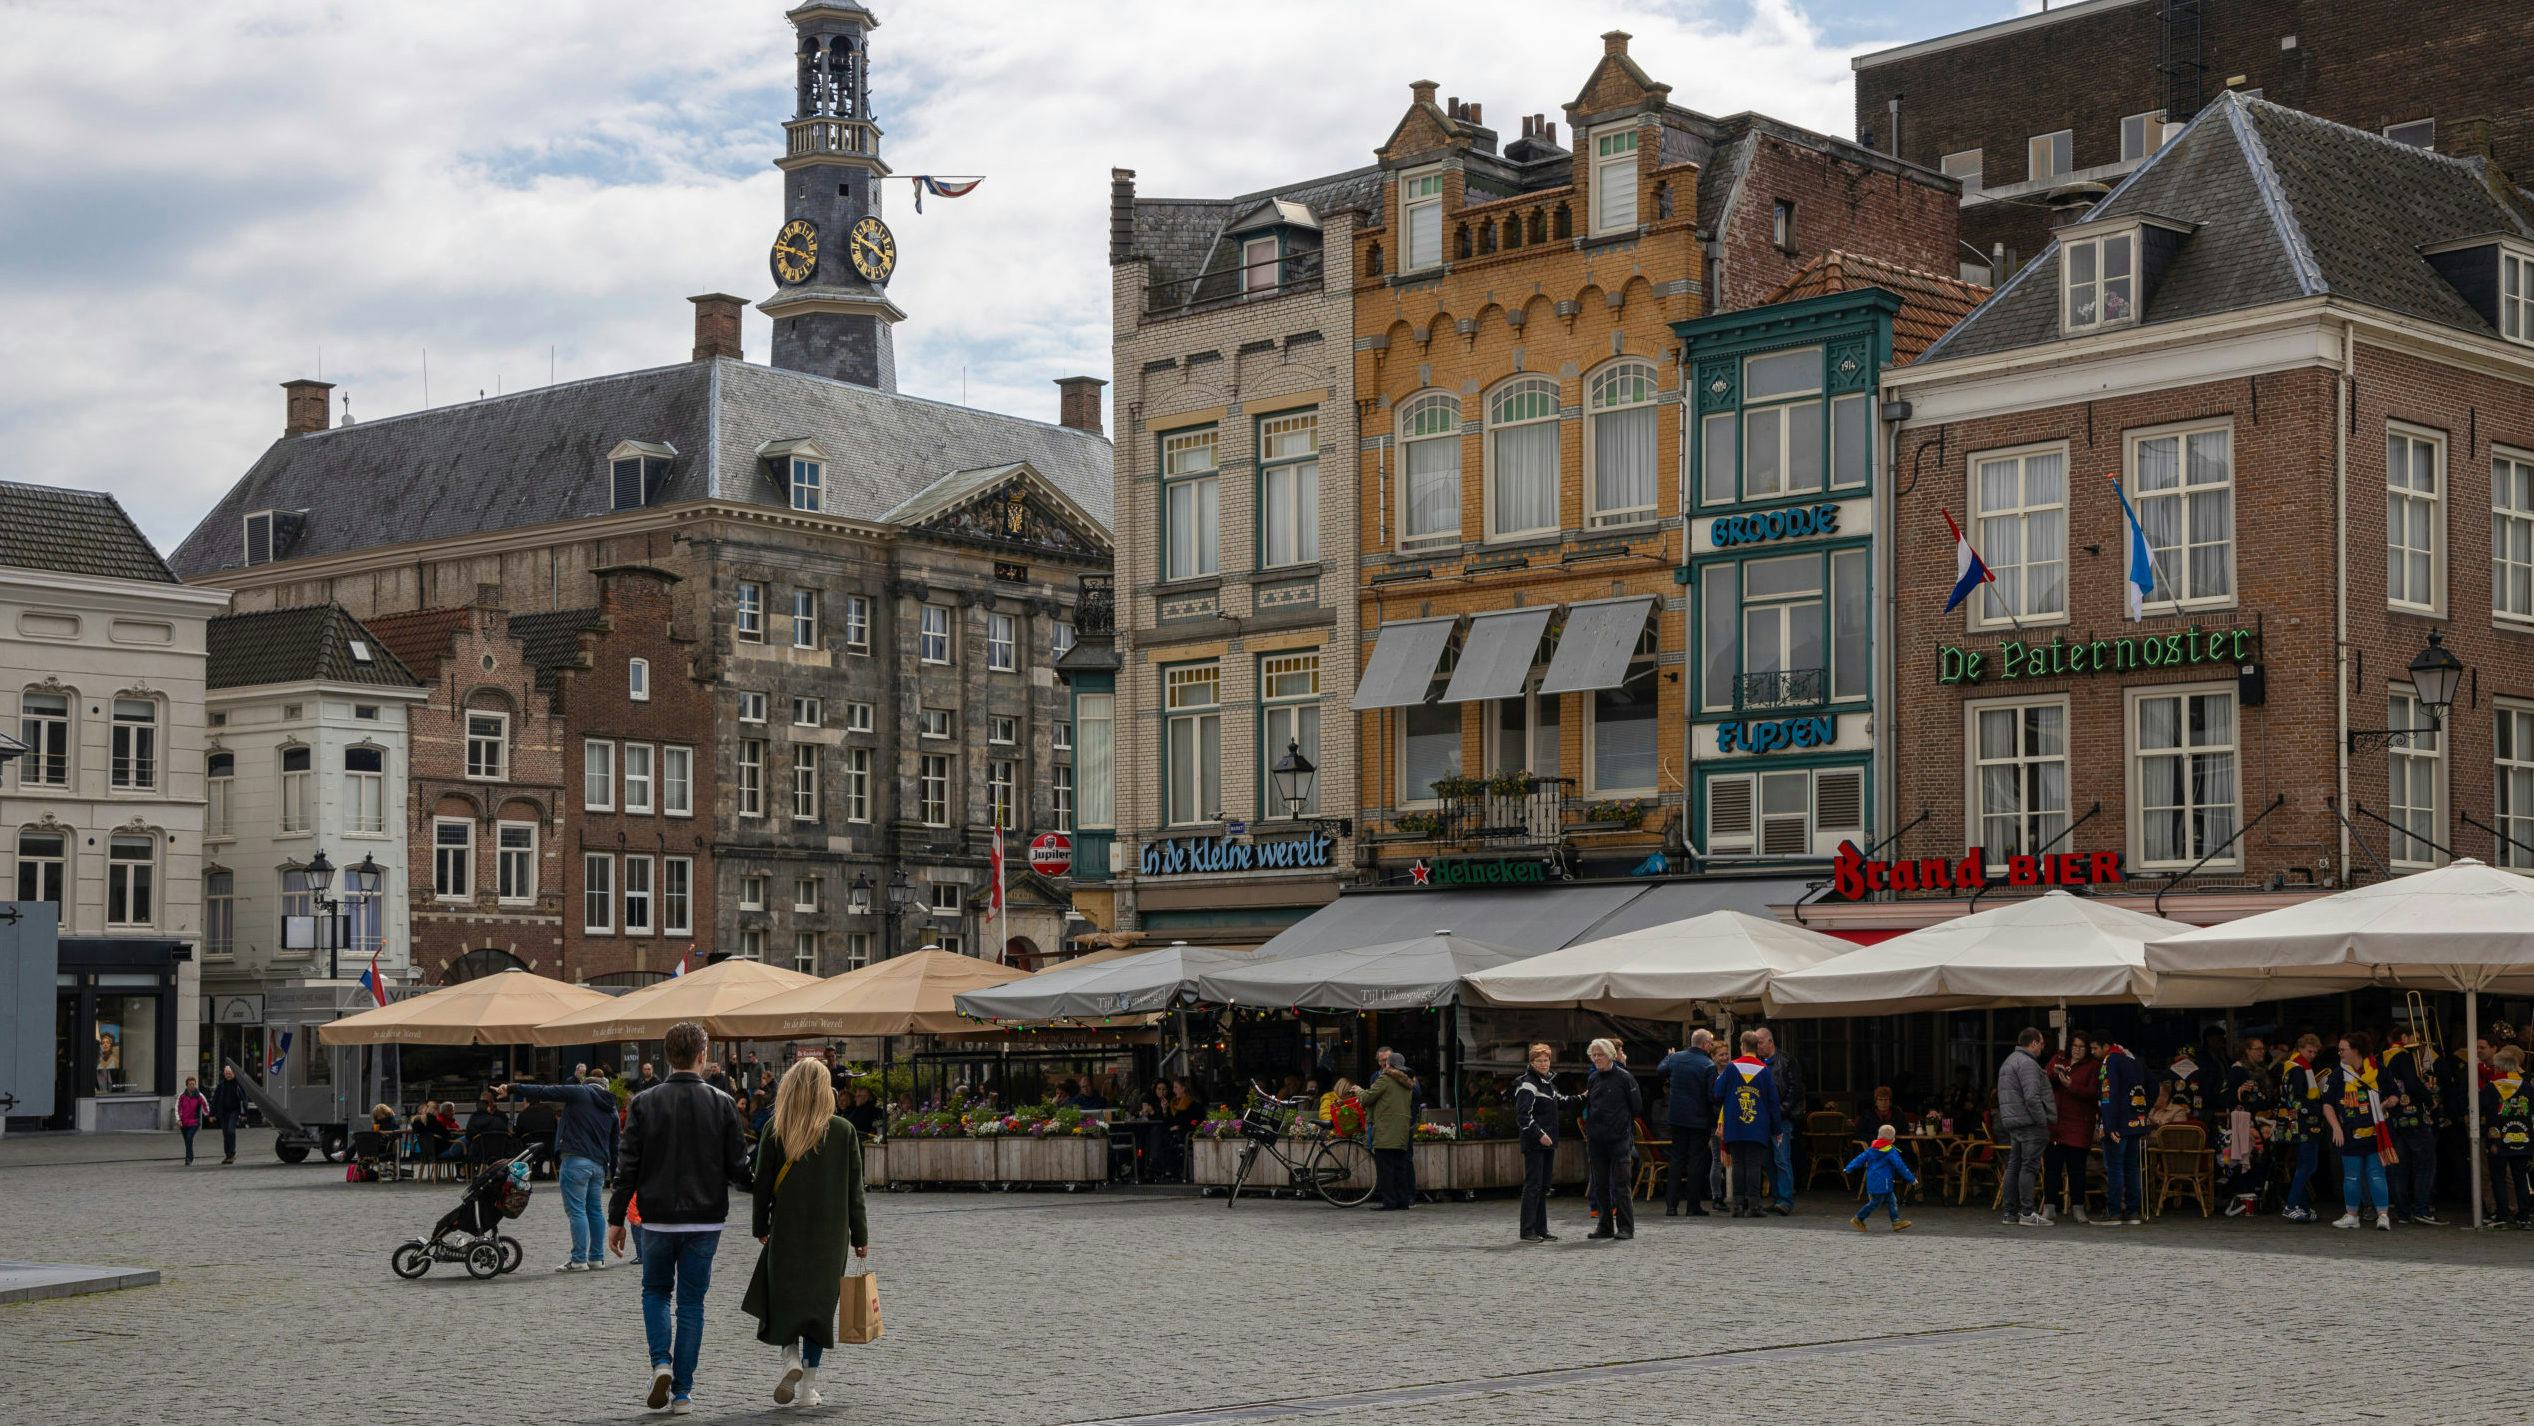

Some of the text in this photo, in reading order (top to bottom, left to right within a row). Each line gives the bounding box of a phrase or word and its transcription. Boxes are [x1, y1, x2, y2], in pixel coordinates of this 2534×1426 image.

[1841, 360, 1856, 371] 1914
[1711, 380, 1727, 392] ANNO
[1711, 503, 1840, 547] BROODJE
[1938, 627, 2250, 684] De Paternoster
[1716, 715, 1837, 753] FLIPSEN
[1032, 849, 1072, 861] Jupiler
[1140, 831, 1332, 876] In de kleine werelt
[1434, 858, 1546, 883] Heineken
[1834, 839, 2126, 901] Brand BIER
[1096, 996, 1113, 1012] Tijl
[1360, 984, 1438, 1004] Tijl Uilenspiegel
